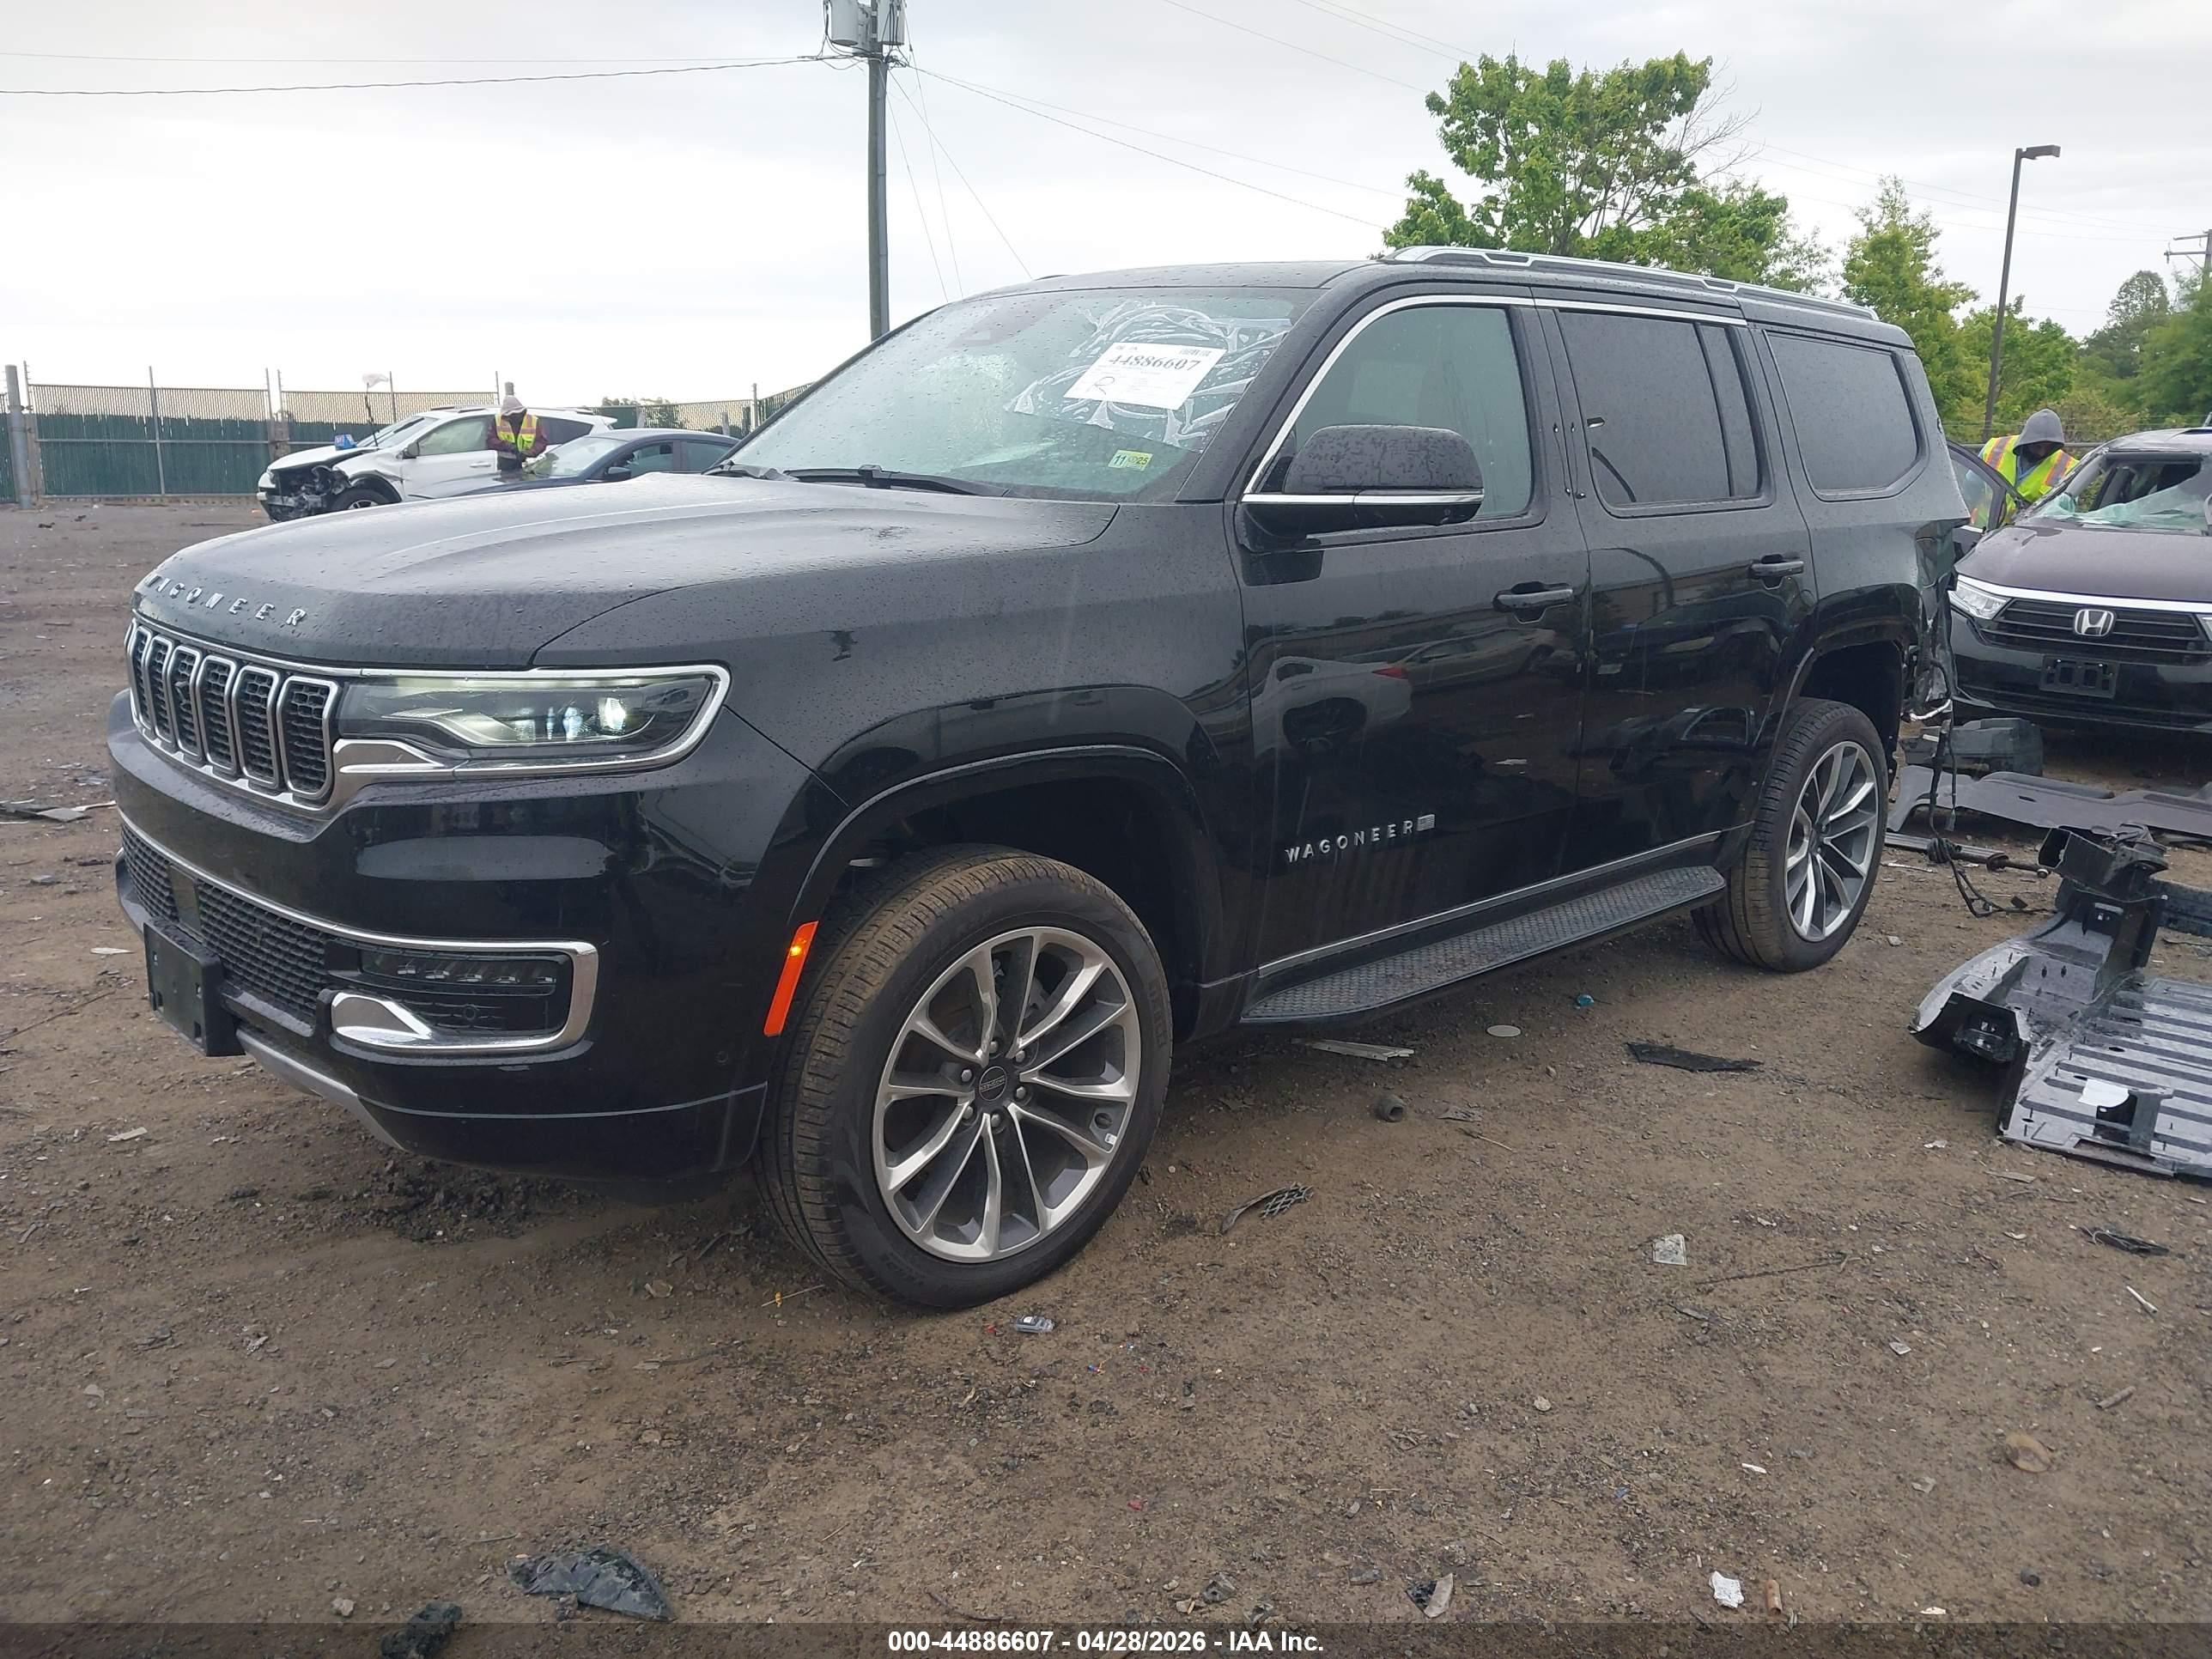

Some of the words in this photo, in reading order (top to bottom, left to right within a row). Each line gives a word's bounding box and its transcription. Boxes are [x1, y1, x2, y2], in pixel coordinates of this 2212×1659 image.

[1109, 354, 1202, 372] 44886607
[1114, 454, 1127, 465] 11
[1136, 456, 1149, 465] 25
[1285, 820, 1414, 863] WAGONEER
